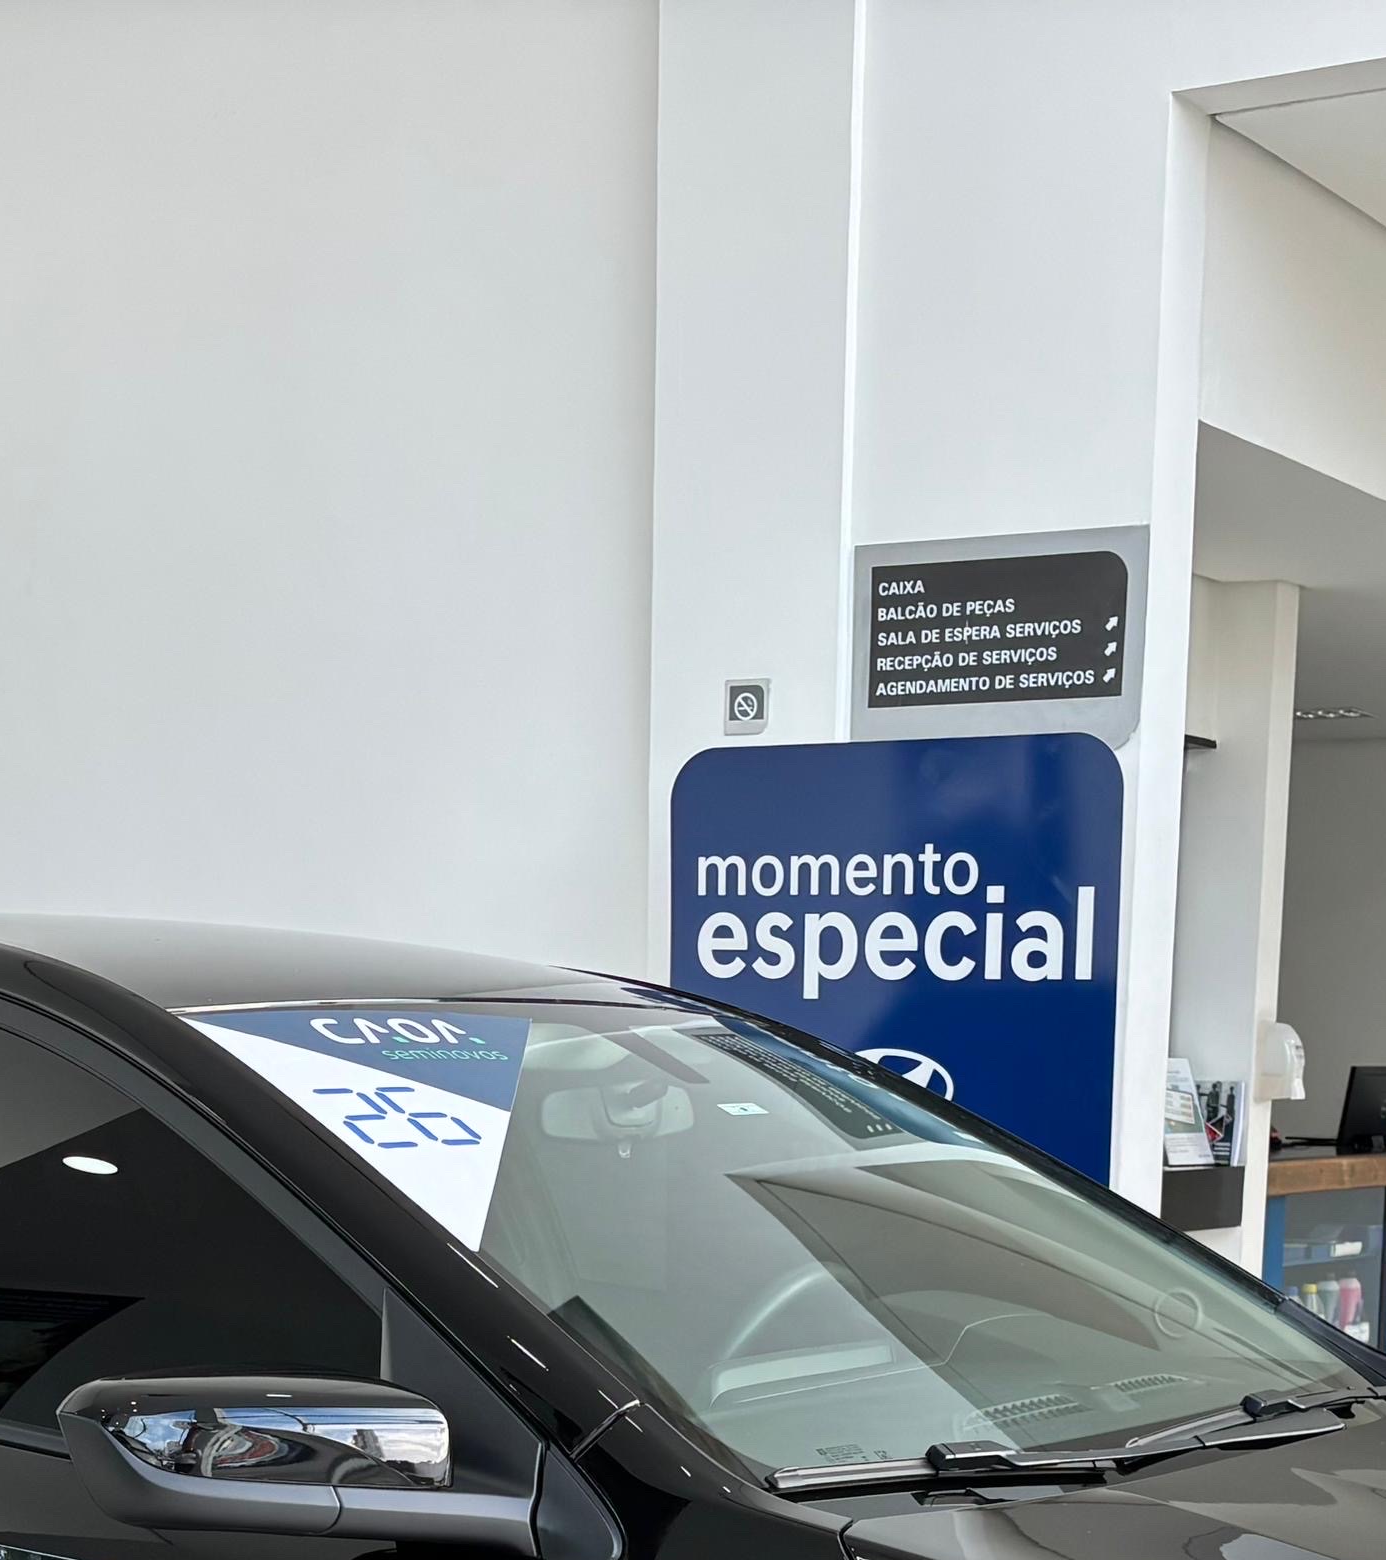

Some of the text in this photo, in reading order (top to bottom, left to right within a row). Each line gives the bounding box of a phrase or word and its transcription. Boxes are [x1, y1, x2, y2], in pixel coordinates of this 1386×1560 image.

[878, 580, 926, 597] CAIXA
[877, 599, 1015, 622] BALCÃO DE PEÇAS
[877, 619, 1082, 647] SALA DE ESPERA SERVIÇOS
[876, 647, 1058, 672] RECEPÇÃO DE SERVIÇOS
[875, 670, 1095, 697] AGENDAMENTO DE SERVIÇOS
[697, 843, 980, 897] momento
[696, 884, 1096, 1000] especial
[381, 1047, 509, 1062] seminovos
[312, 1086, 483, 1149] 26
